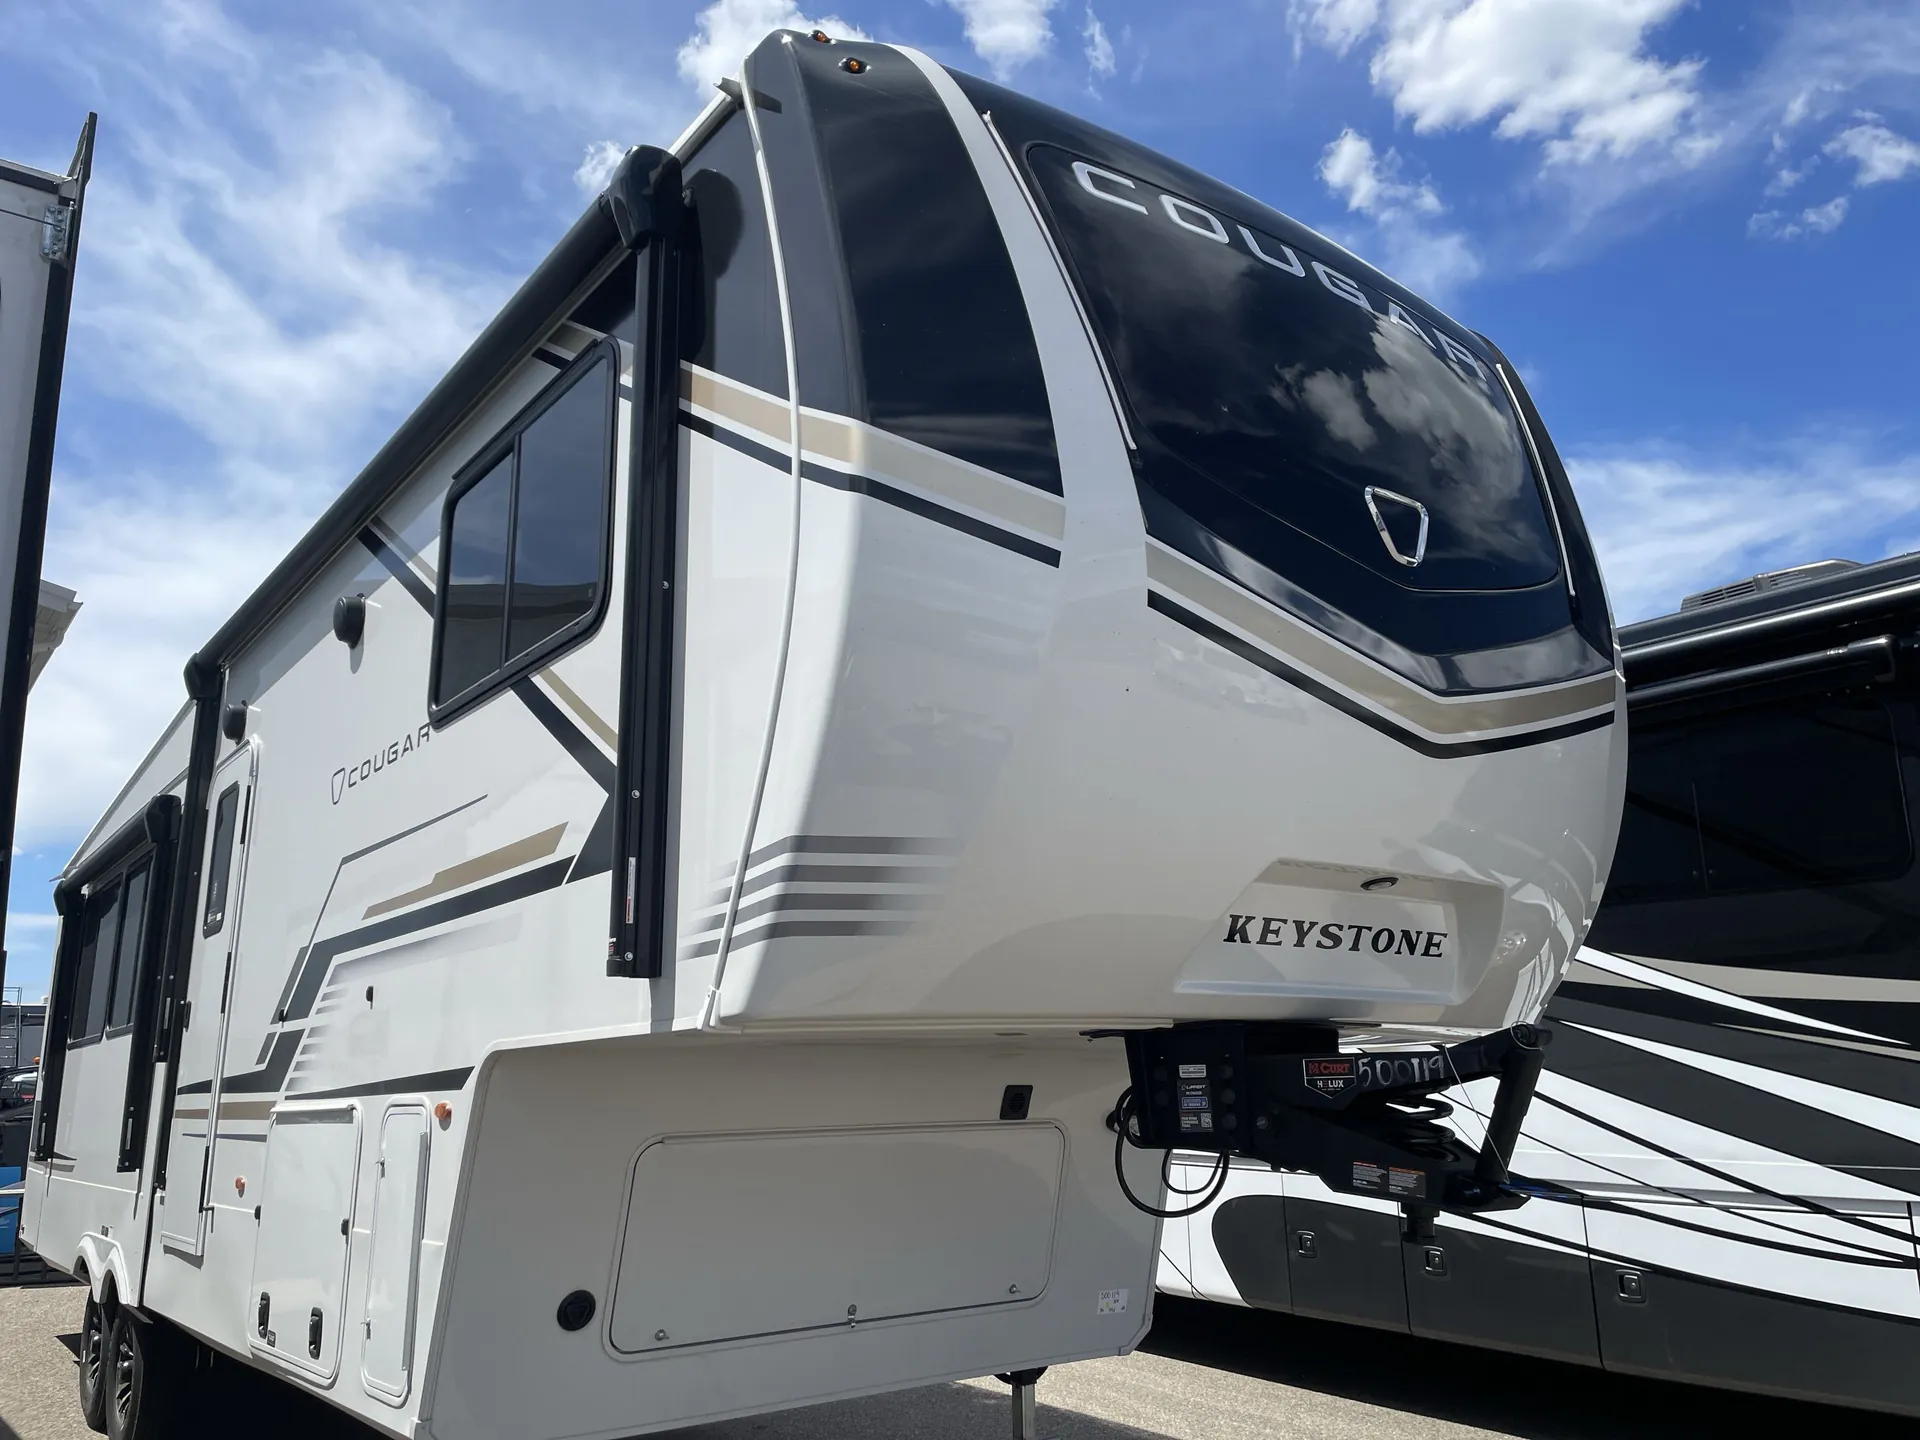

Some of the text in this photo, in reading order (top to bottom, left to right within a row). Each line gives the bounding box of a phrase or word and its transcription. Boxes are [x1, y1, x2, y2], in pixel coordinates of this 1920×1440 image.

[1071, 160, 1486, 382] COUGAR
[348, 721, 430, 788] COUGAR
[1223, 914, 1448, 958] KEYSTONE
